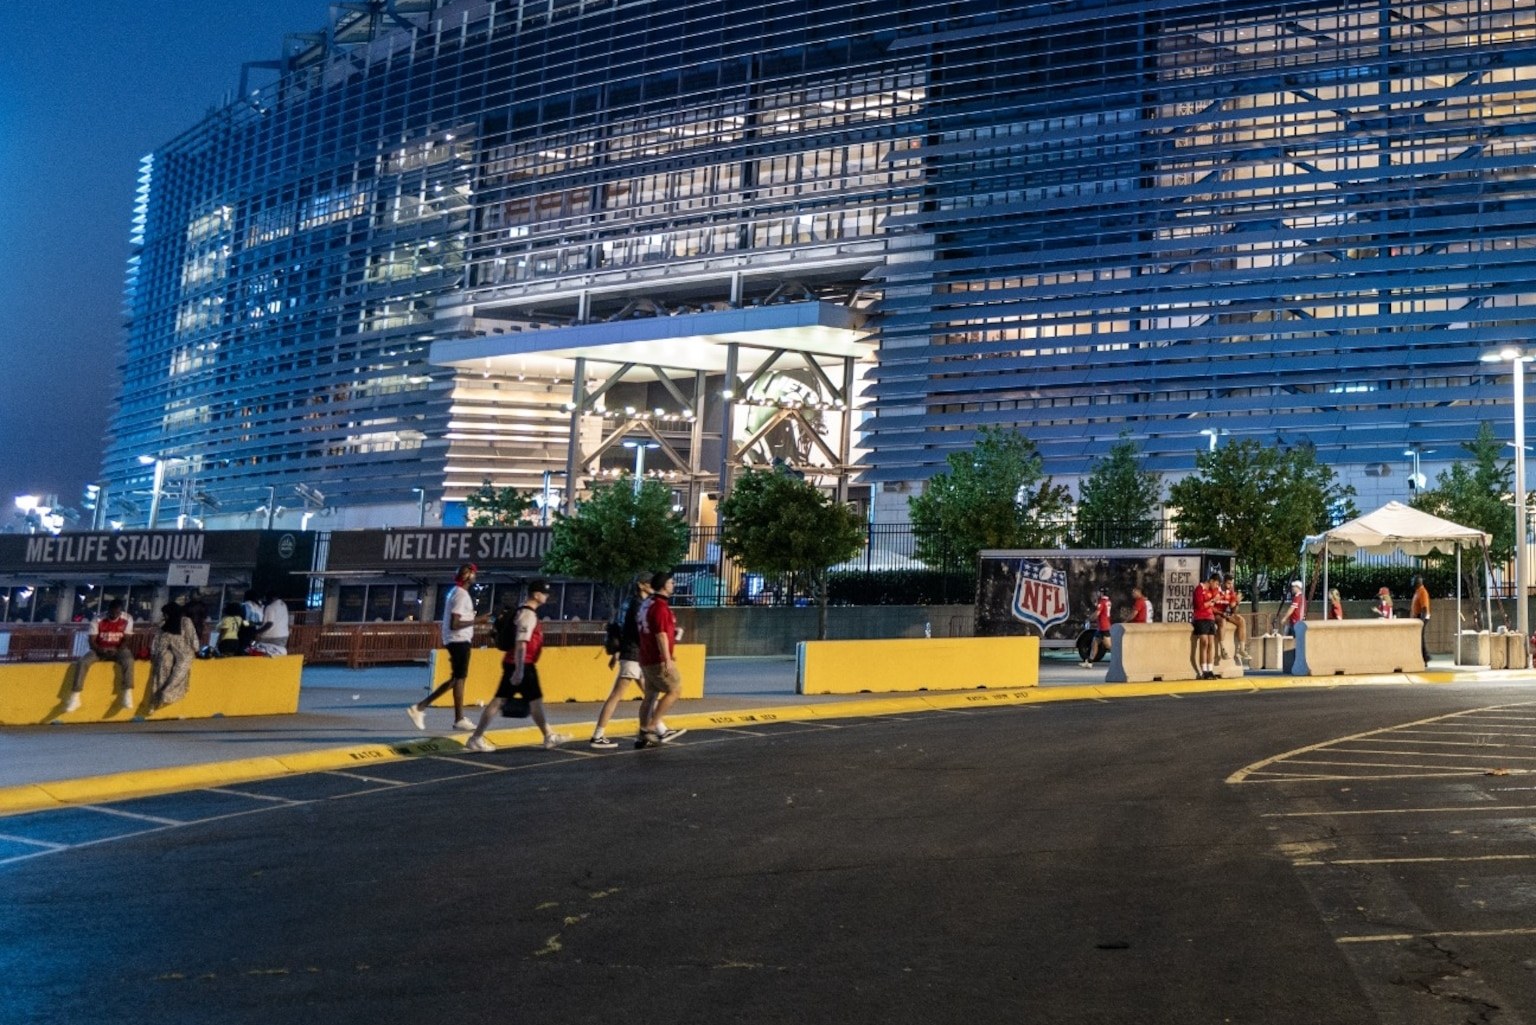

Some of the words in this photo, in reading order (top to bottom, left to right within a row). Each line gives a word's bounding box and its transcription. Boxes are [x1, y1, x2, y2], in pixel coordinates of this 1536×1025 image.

[25, 535, 110, 563] METLIFE
[114, 533, 205, 562] STADIUM
[383, 532, 472, 560] METLIFE
[477, 532, 553, 558] STADIU
[1170, 572, 1191, 583] GET
[1021, 579, 1065, 618] NFL
[349, 750, 384, 760] WATCH
